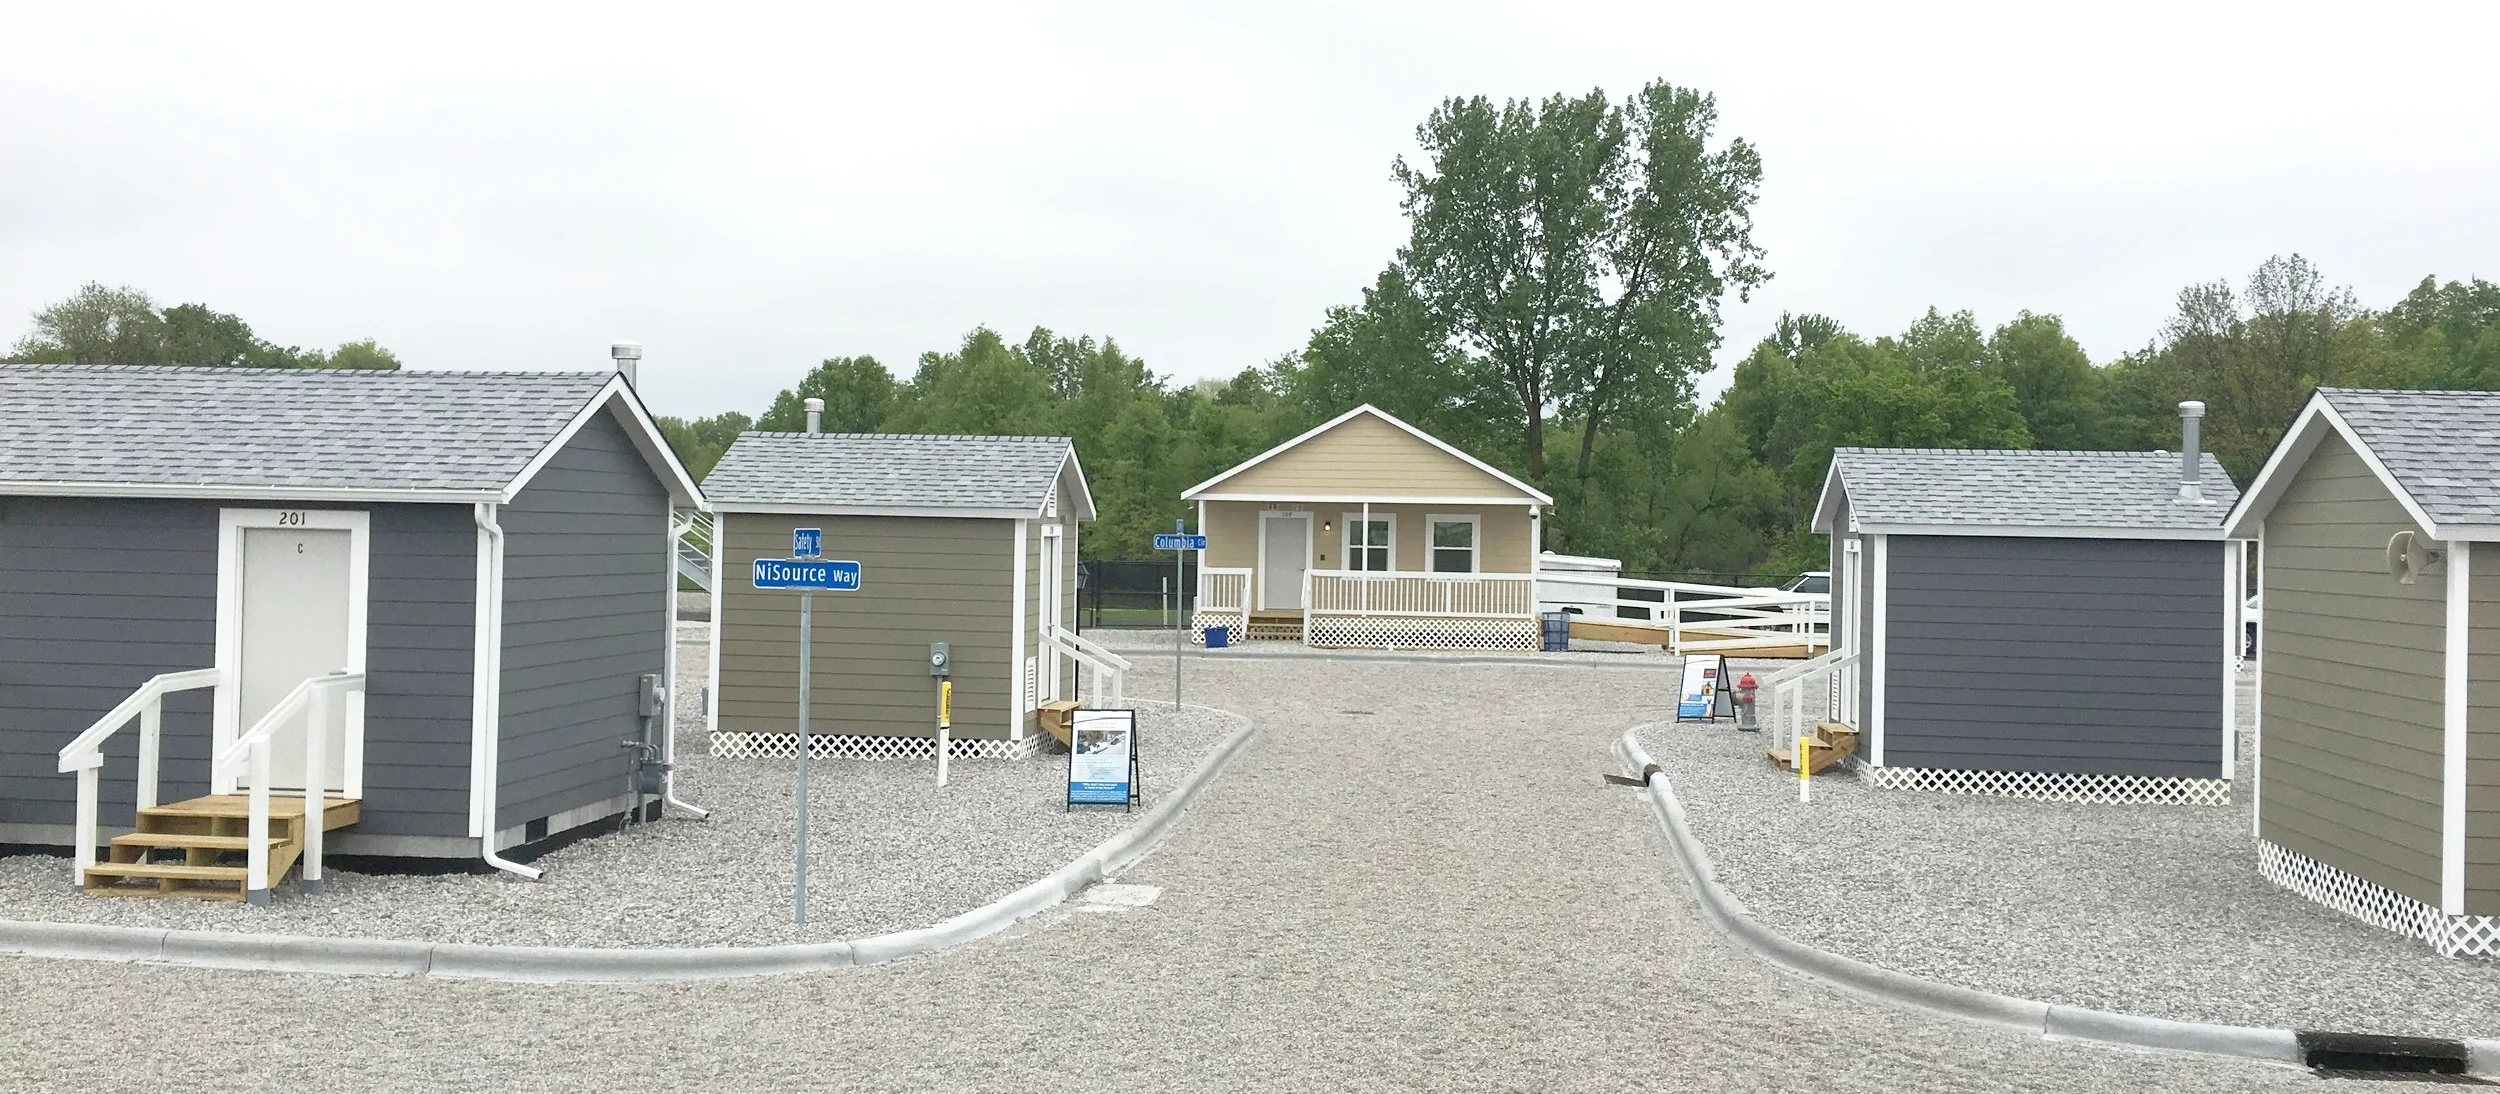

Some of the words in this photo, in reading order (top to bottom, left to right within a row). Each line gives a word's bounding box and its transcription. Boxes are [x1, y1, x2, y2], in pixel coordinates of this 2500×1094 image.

[279, 511, 305, 526] 201
[297, 543, 304, 554] C
[795, 532, 812, 554] Safety
[1155, 536, 1194, 548] Columbia
[756, 563, 826, 582] NiSource
[833, 569, 858, 587] Way
